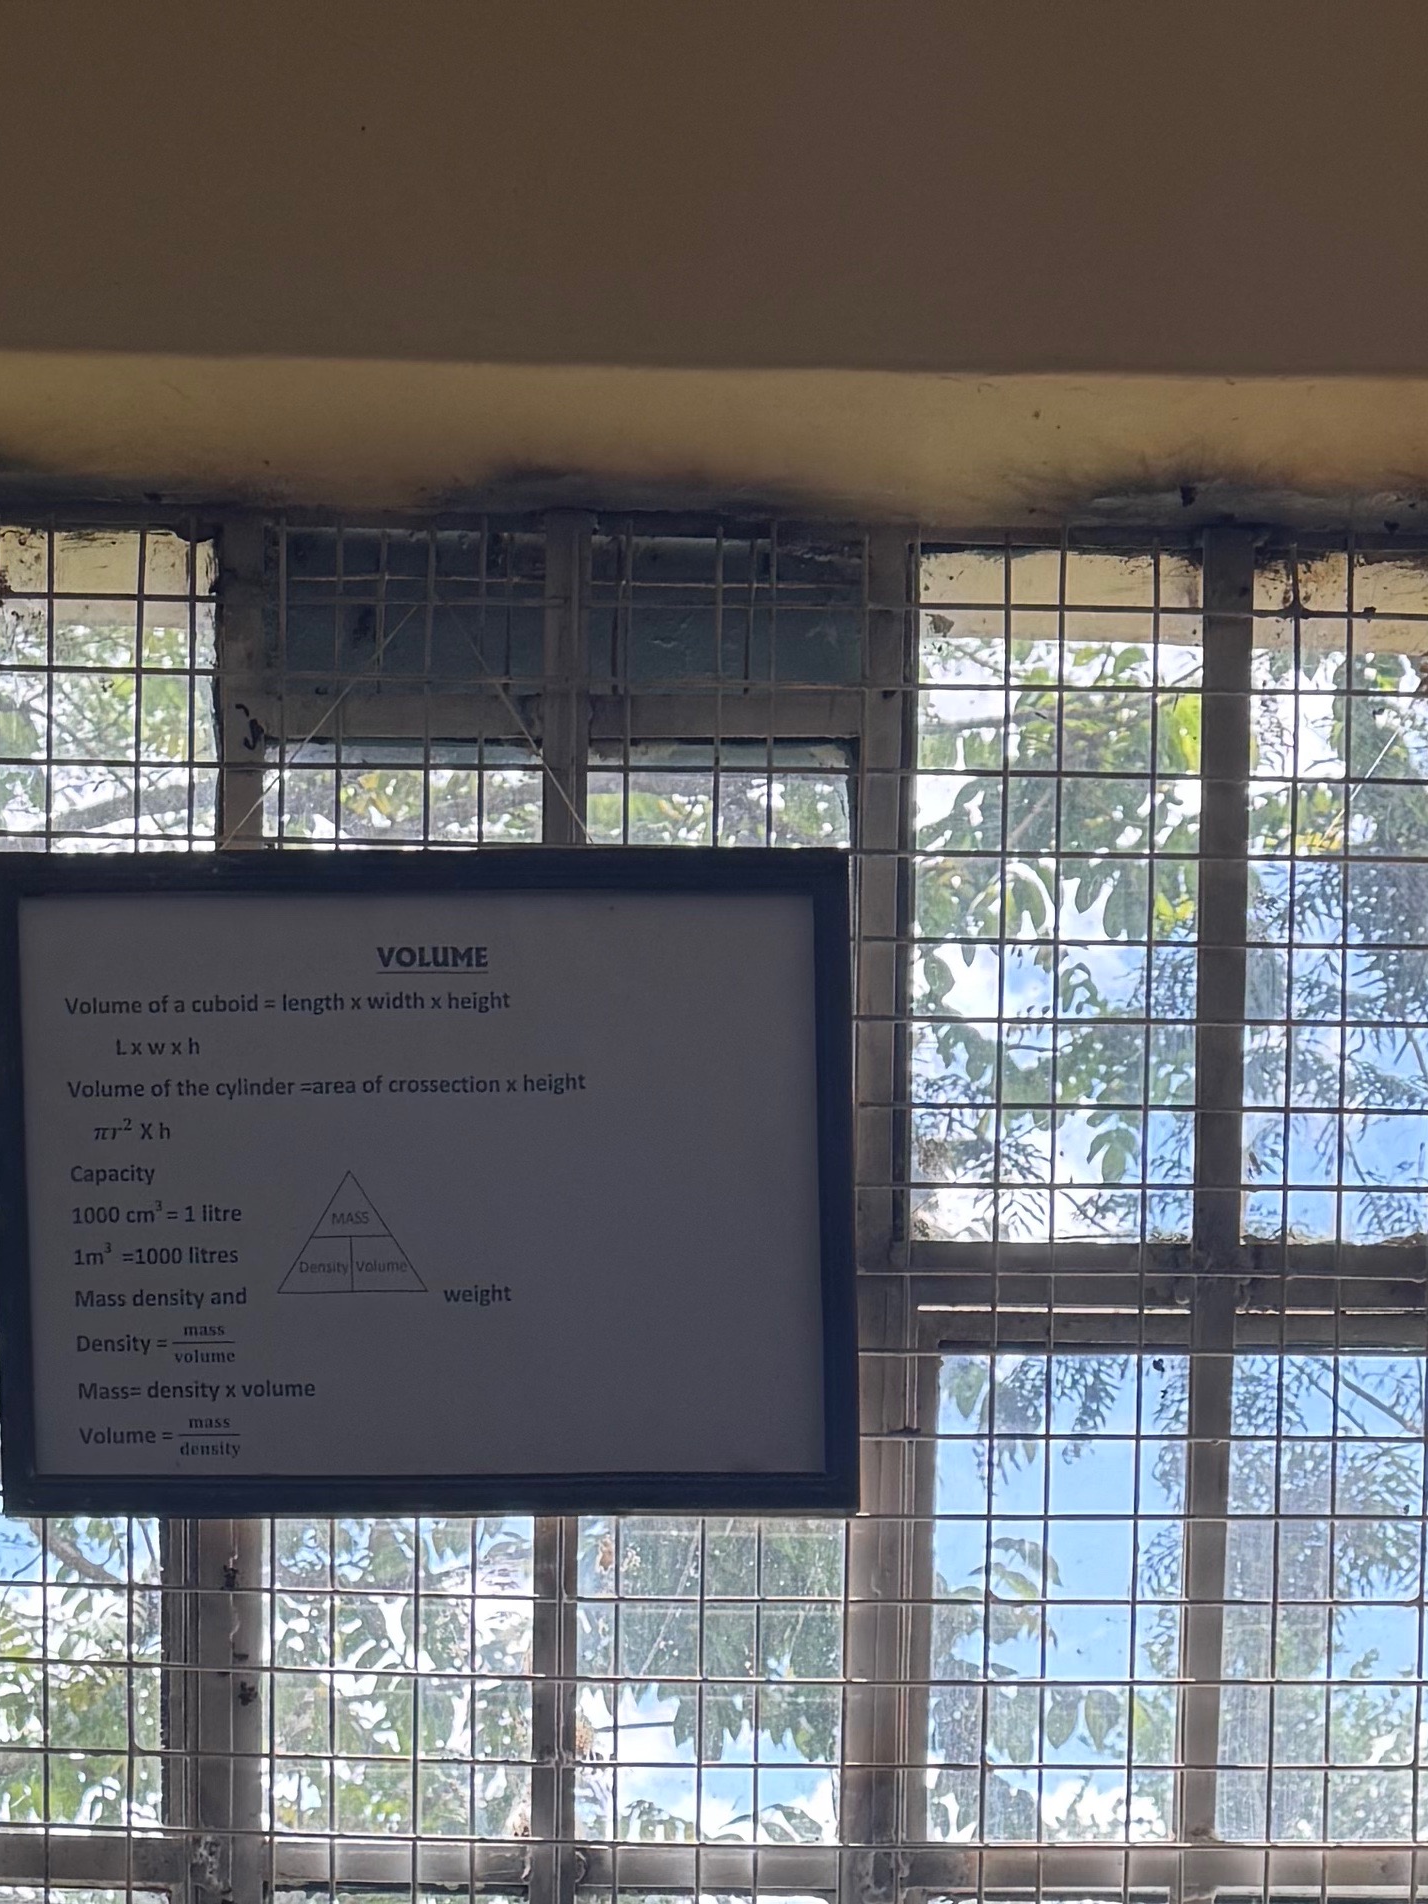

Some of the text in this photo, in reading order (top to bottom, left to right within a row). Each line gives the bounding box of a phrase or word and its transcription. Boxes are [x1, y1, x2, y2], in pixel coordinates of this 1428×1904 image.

[377, 946, 488, 969] VOLUME
[66, 991, 511, 1017] Volume of a cuboid length x width x height
[115, 1037, 201, 1056] L x w x h
[67, 1073, 586, 1102] Volume of the cylinder =area of crossection x height
[159, 1121, 171, 1140] h
[70, 1164, 155, 1187] Capacity
[72, 1207, 120, 1224] 1000
[185, 1205, 196, 1222] 1
[202, 1205, 242, 1222] litre
[331, 1211, 370, 1226] MASS
[189, 1246, 239, 1264] litres
[298, 1259, 408, 1276] Density Volume
[75, 1285, 512, 1311] Mass density and weight
[76, 1324, 225, 1356] Density mass
[174, 1349, 236, 1364] volume
[78, 1380, 316, 1403] Mass= density x volume
[79, 1416, 230, 1445] Volume mass
[180, 1442, 241, 1460] density
